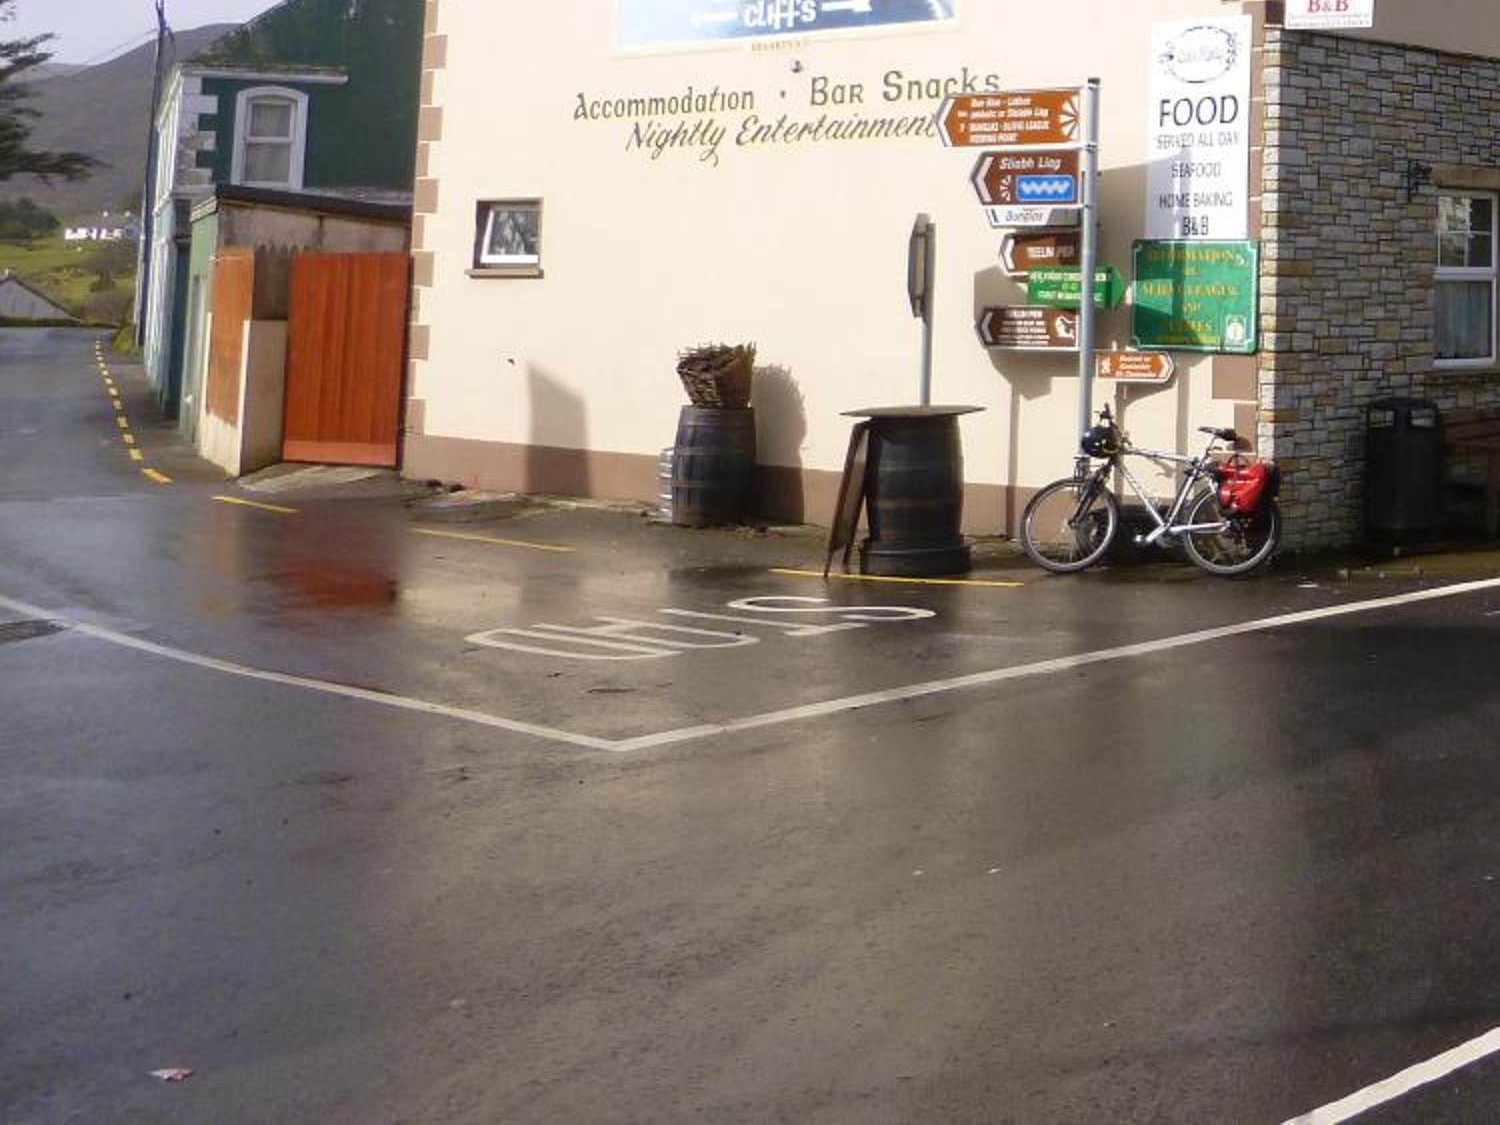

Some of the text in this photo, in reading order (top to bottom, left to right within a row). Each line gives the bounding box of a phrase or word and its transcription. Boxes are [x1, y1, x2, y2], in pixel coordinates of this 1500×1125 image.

[574, 85, 755, 120] Accommodation
[883, 66, 1000, 102] Snacks
[1160, 94, 1239, 127] FOOD
[625, 118, 727, 168] Nightly
[1157, 130, 1239, 150] SERVED ALL DAY
[1000, 156, 1062, 171] Sliabh Liag
[1171, 162, 1221, 178] SEAFOOD
[1159, 191, 1233, 208] HOME BAKING
